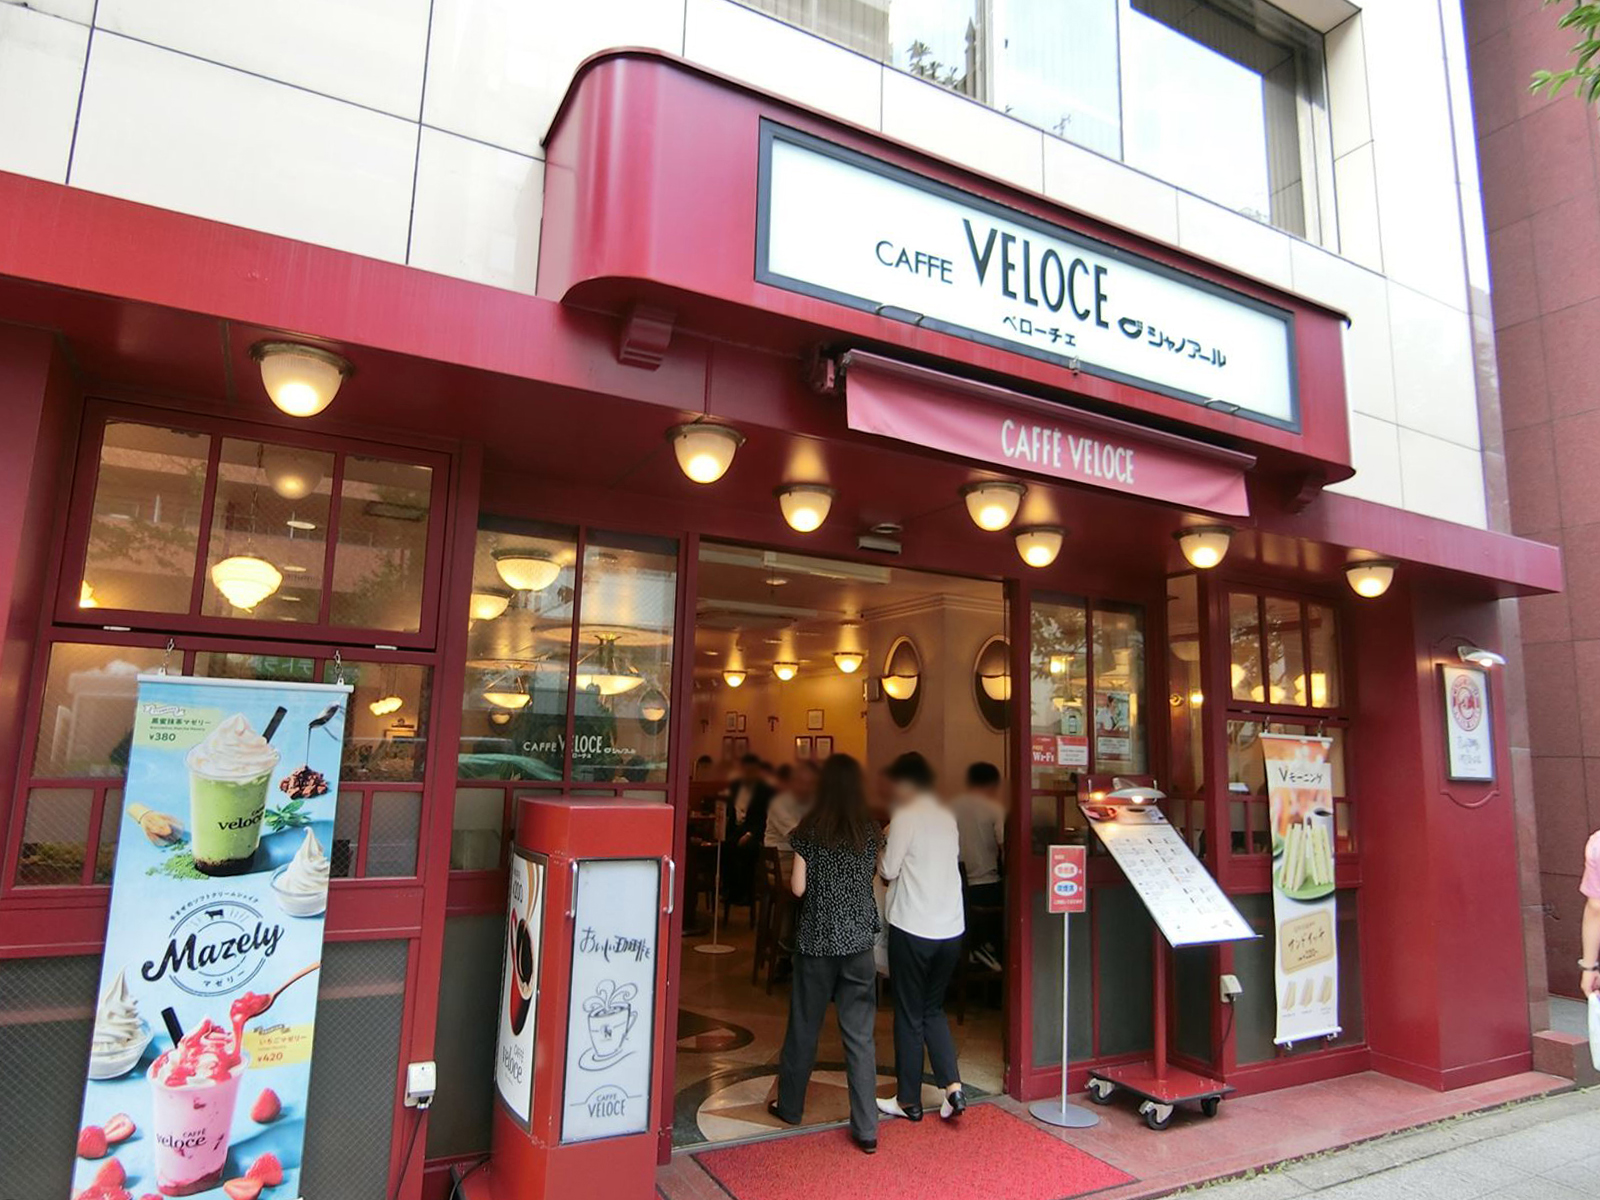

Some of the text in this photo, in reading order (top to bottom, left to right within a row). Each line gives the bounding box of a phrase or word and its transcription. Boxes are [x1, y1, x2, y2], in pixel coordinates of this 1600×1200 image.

[875, 217, 1109, 329] CAFFE VELOCE
[1002, 316, 1077, 347] ベローチェ
[1147, 325, 1227, 368] シャノアール
[1067, 434, 1134, 485] VELOCE
[149, 732, 176, 742] ¥380
[558, 734, 603, 753] VLOCE
[141, 921, 285, 982] Mazely
[588, 1099, 626, 1117] VELOCE
